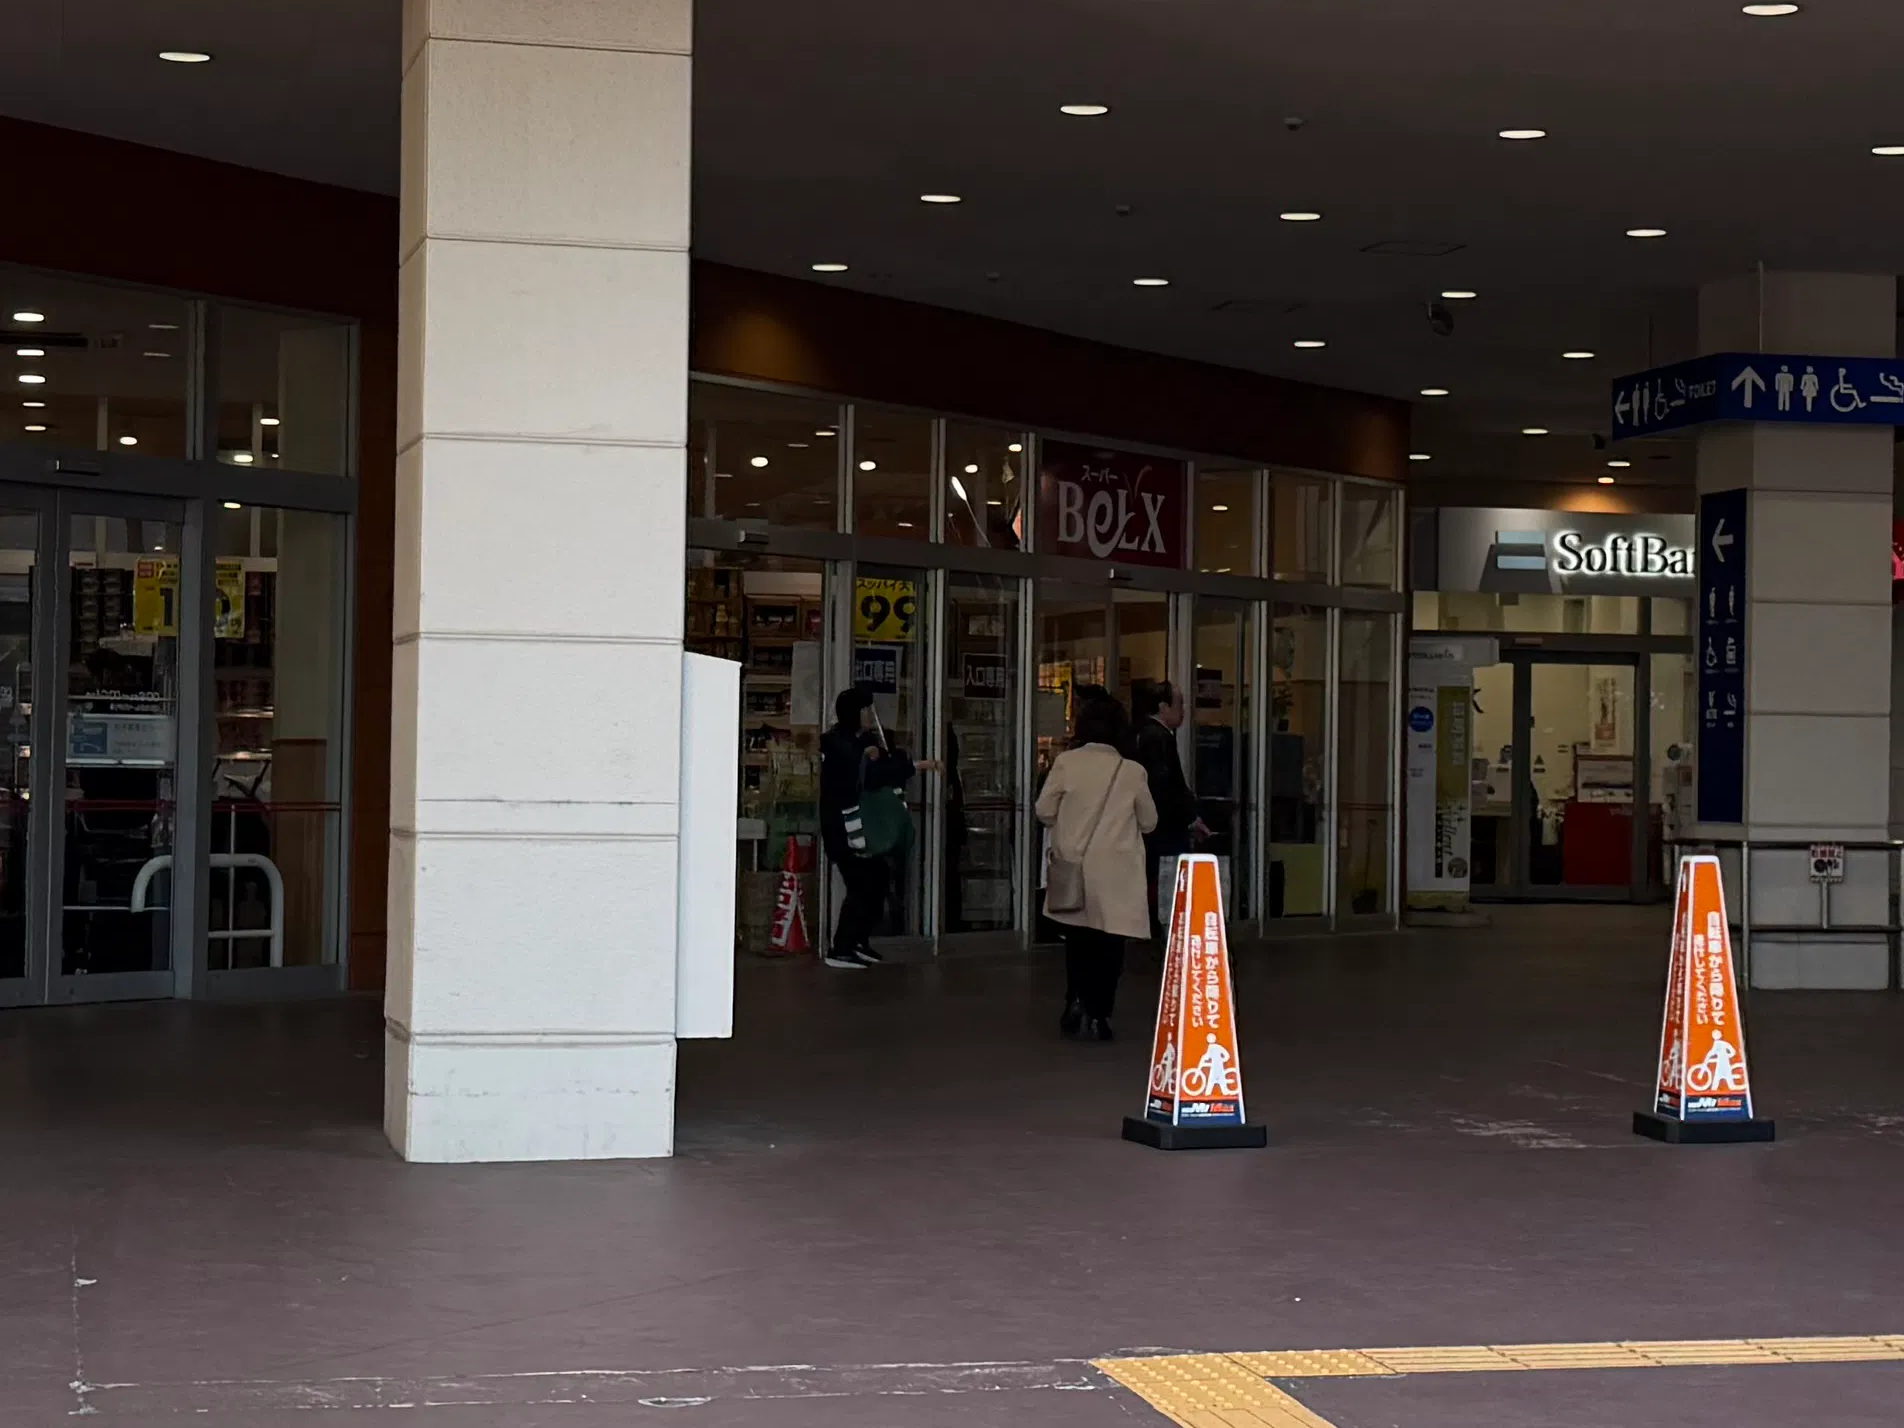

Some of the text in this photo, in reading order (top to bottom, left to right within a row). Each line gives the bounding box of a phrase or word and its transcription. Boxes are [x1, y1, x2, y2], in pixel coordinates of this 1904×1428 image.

[1081, 464, 1118, 484] スーパー
[1554, 532, 1695, 575] SoftBa
